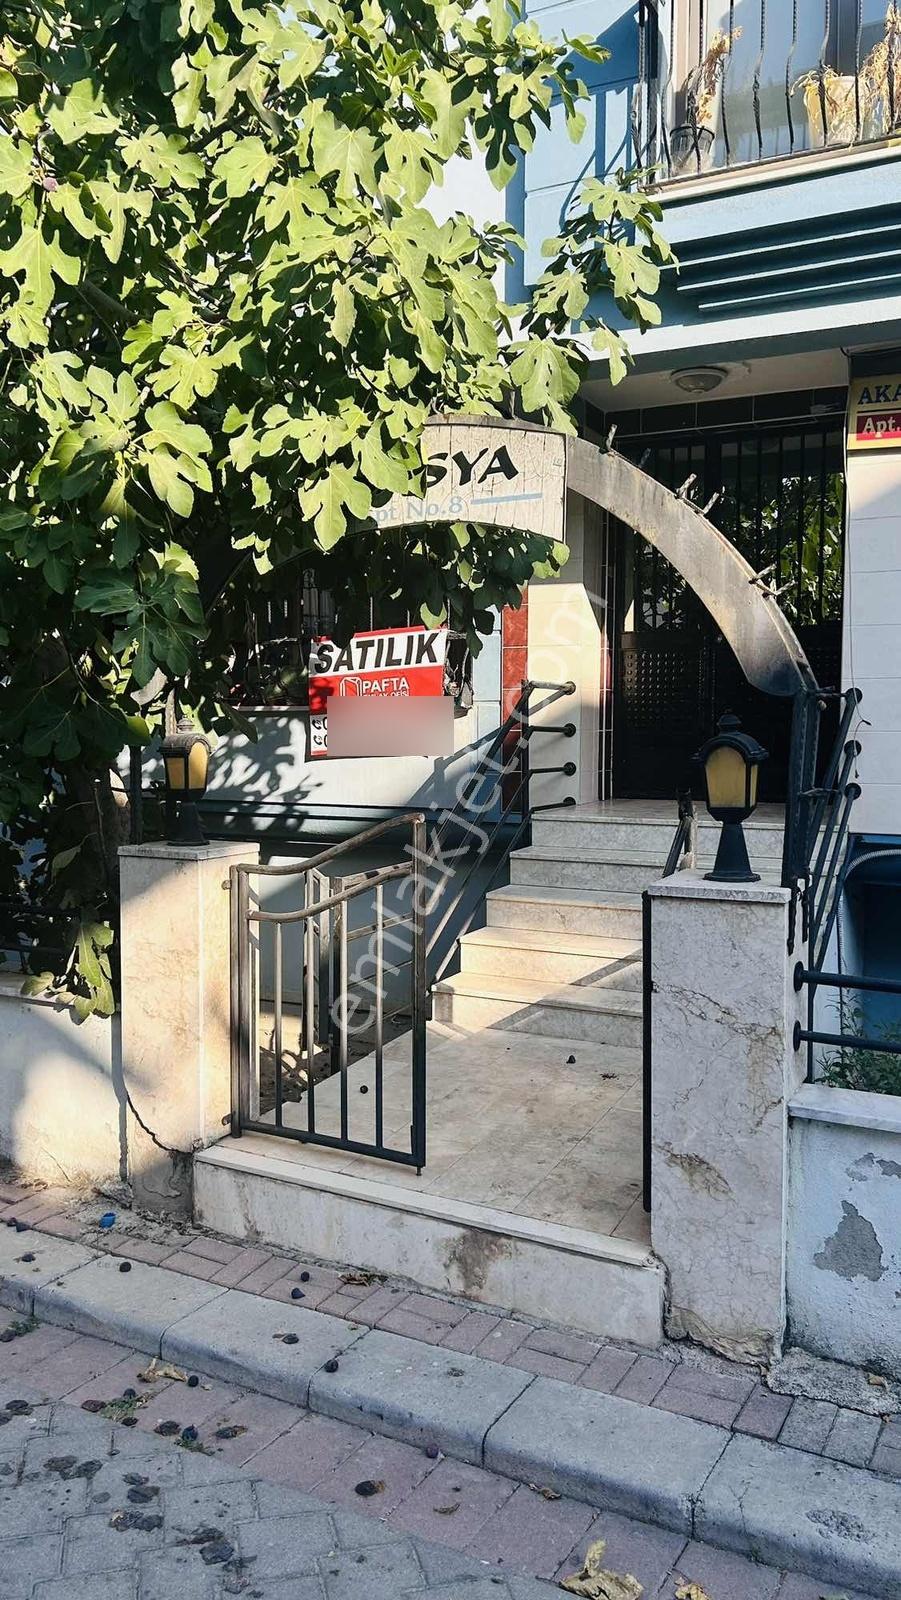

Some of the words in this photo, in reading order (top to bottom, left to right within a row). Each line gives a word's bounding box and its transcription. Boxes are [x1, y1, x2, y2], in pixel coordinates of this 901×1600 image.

[863, 417, 901, 437] Apt.
[426, 445, 519, 487] SYA
[374, 505, 395, 522] pt
[315, 633, 440, 673] SATILIK
[362, 677, 410, 693] PAFTA
